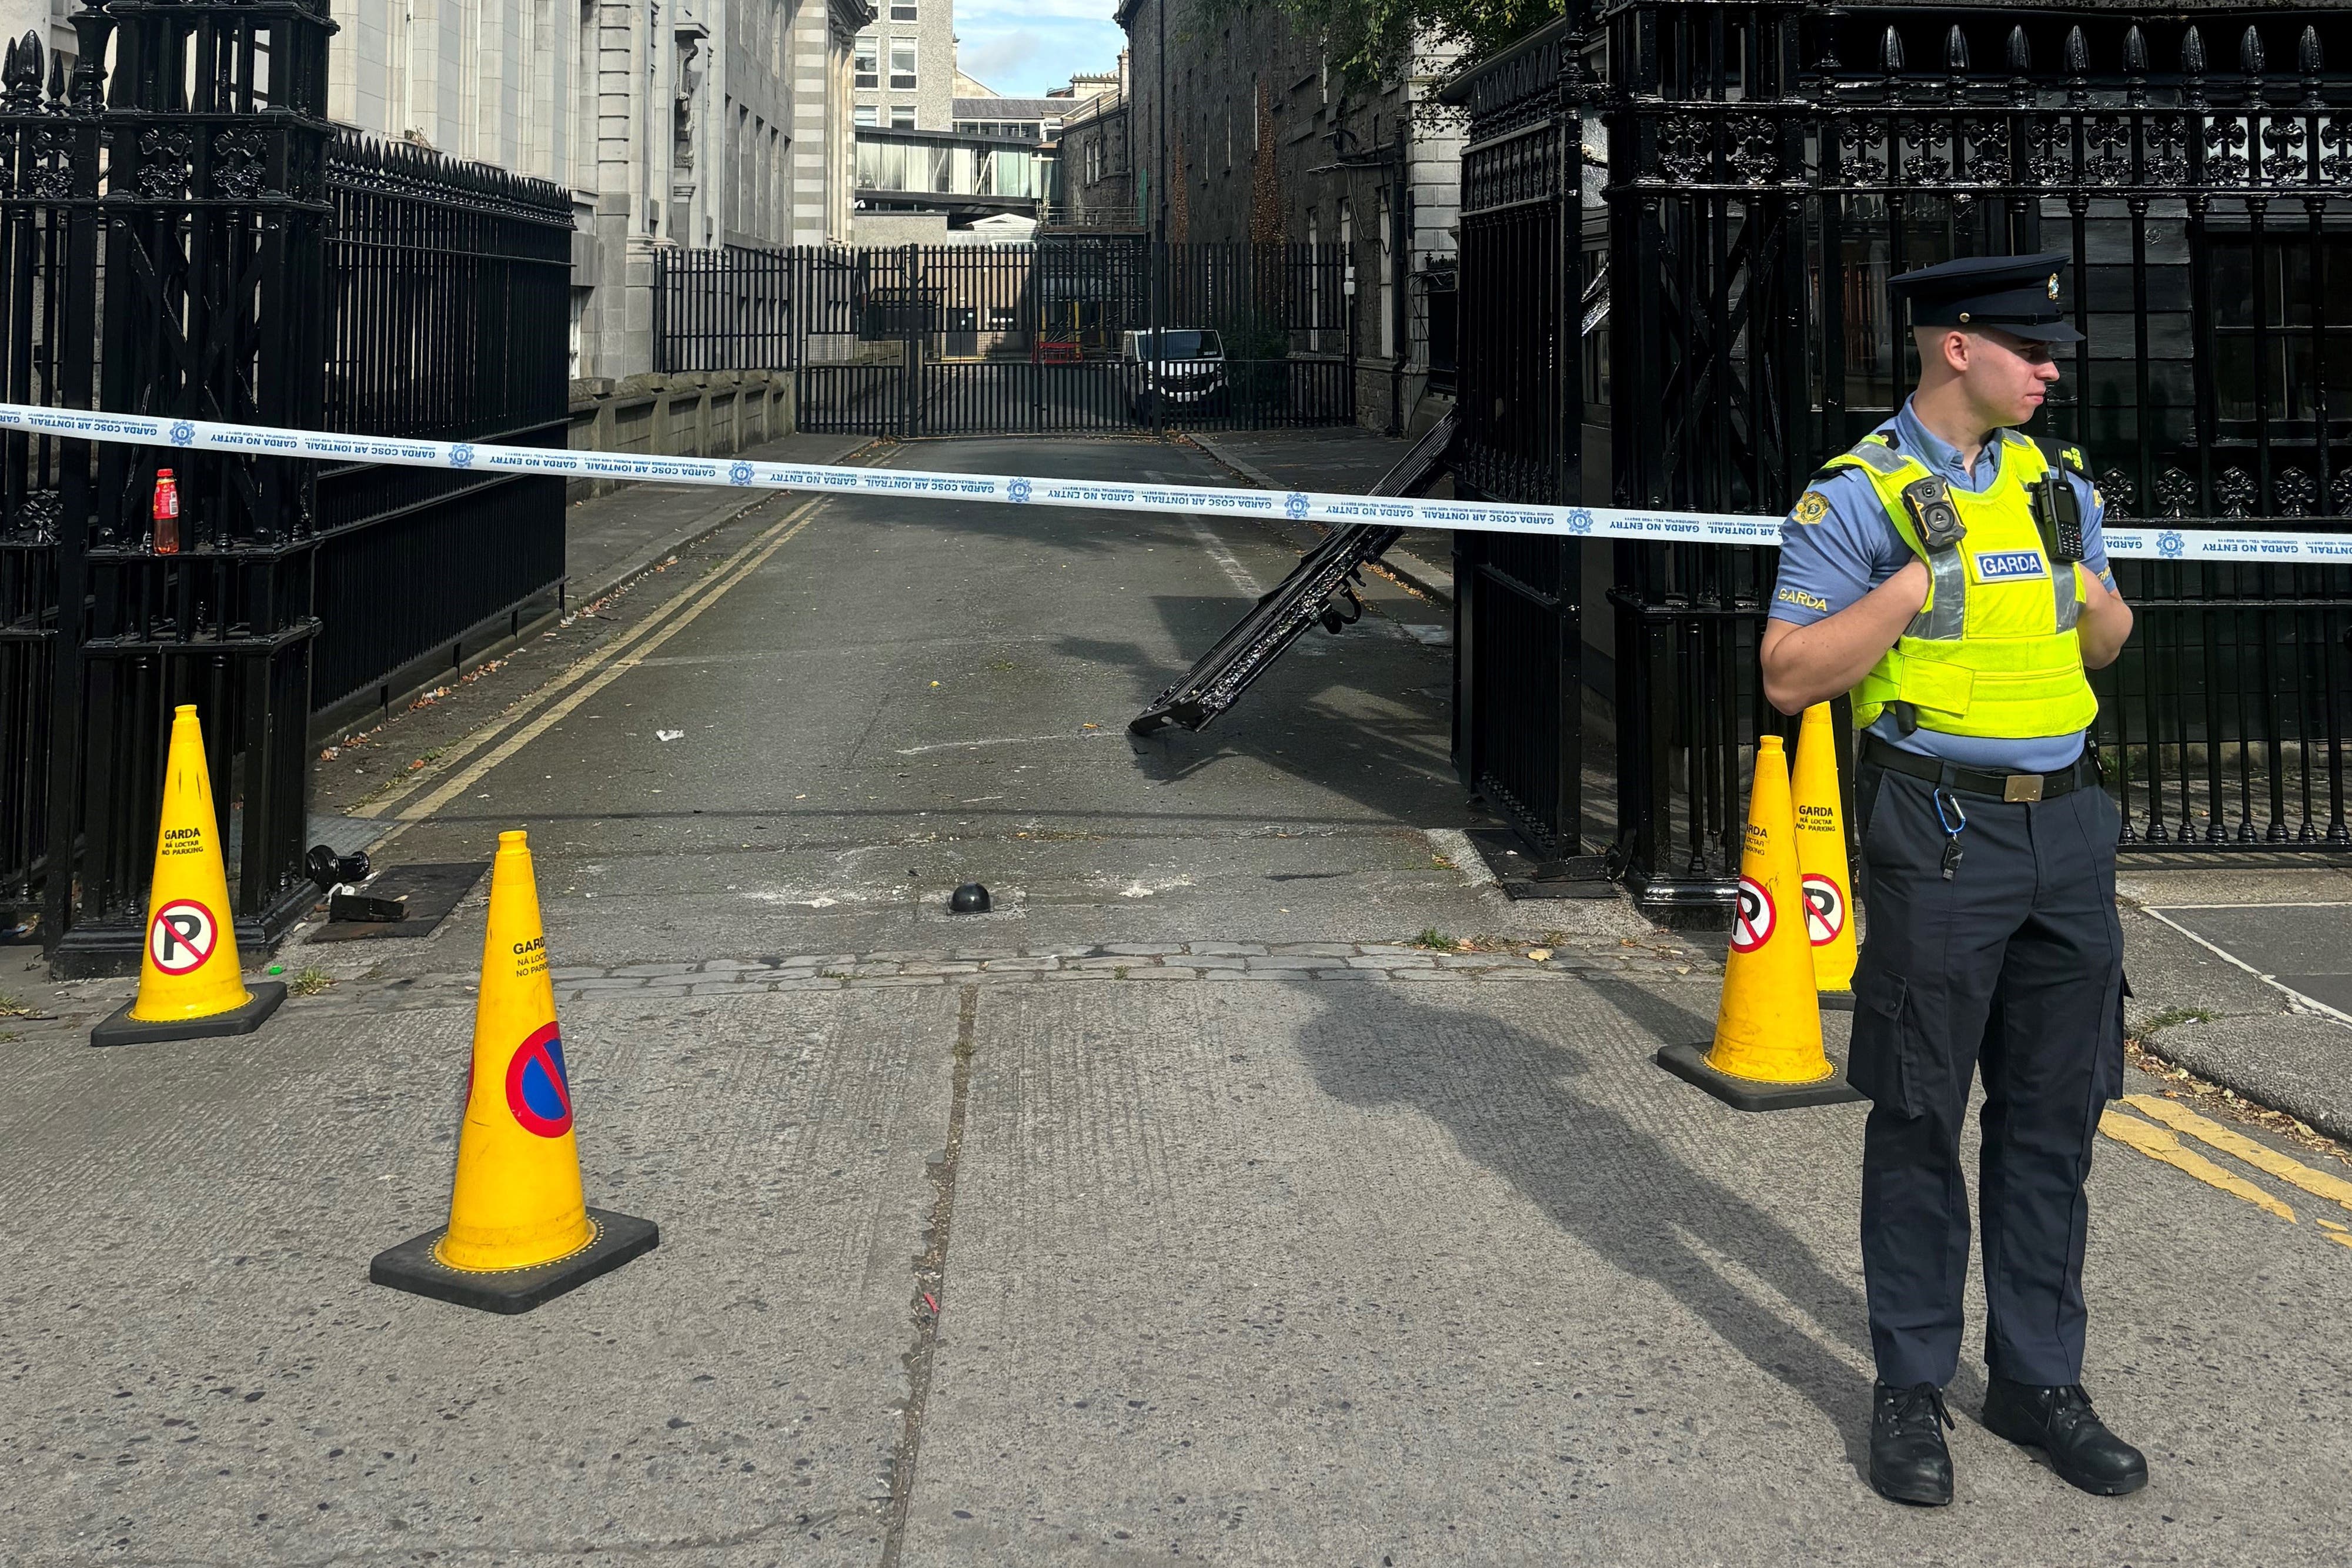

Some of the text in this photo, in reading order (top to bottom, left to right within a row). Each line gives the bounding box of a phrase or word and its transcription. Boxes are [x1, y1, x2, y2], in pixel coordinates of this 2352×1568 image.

[0, 414, 19, 424] GAR
[28, 416, 74, 429] IONTRAIL
[78, 421, 91, 430] AR
[94, 423, 120, 433] COSC
[123, 425, 156, 436] GARDA
[211, 433, 243, 444] ENTRY
[246, 436, 260, 445] NO
[263, 438, 296, 448] GARDA
[305, 442, 351, 452] IONTRAIL
[354, 445, 368, 453] AR
[371, 447, 398, 456] COSC
[402, 449, 435, 459] GARDA
[489, 456, 522, 465] ENTRY
[543, 459, 576, 469] GARDA
[584, 462, 632, 472] IONTRAIL
[652, 466, 678, 474] COSC
[681, 467, 715, 477] GARDA
[769, 472, 803, 483] ENTRY
[807, 474, 820, 483] NO
[824, 476, 856, 486] GARDA
[865, 479, 911, 489] IONTRAIL
[914, 481, 928, 490] AR
[931, 482, 957, 491] COSC
[961, 484, 994, 493] GARDA
[1047, 489, 1080, 499] ENTRY
[1083, 492, 1097, 500] NO
[1101, 492, 1134, 502] GARDA
[1142, 494, 1188, 504] IONTRAIL
[1192, 497, 1205, 506] AR
[1208, 498, 1235, 507] COSC
[1238, 499, 1271, 509] GARDA
[1325, 504, 1358, 514] ENTRY
[1362, 507, 1376, 516] NO
[1379, 508, 1413, 517] GARDA
[1422, 510, 1469, 520] IONTRAIL
[1472, 513, 1486, 521] AR
[1489, 514, 1516, 523] COSC
[1519, 515, 1553, 524] GARDA
[1609, 520, 1643, 530] ENTRY
[1646, 522, 1661, 530] NO
[1664, 523, 1699, 533] GARDA
[1708, 525, 1756, 535] IONTRAIL
[1760, 527, 1774, 536] AR
[2106, 540, 2142, 549] GARDA
[2203, 543, 2298, 553] GARDA NO ENTRY
[2307, 546, 2352, 554] NTRAIL
[1983, 556, 2040, 574] GARDA
[1778, 588, 1828, 611] GARDA
[1799, 805, 1833, 817] GARDA
[165, 828, 201, 840] GARDA
[1748, 824, 1768, 838] RDA
[172, 847, 203, 855] PARKING
[513, 937, 544, 955] GARD
[517, 956, 529, 966] NÁ
[516, 968, 529, 978] NO
